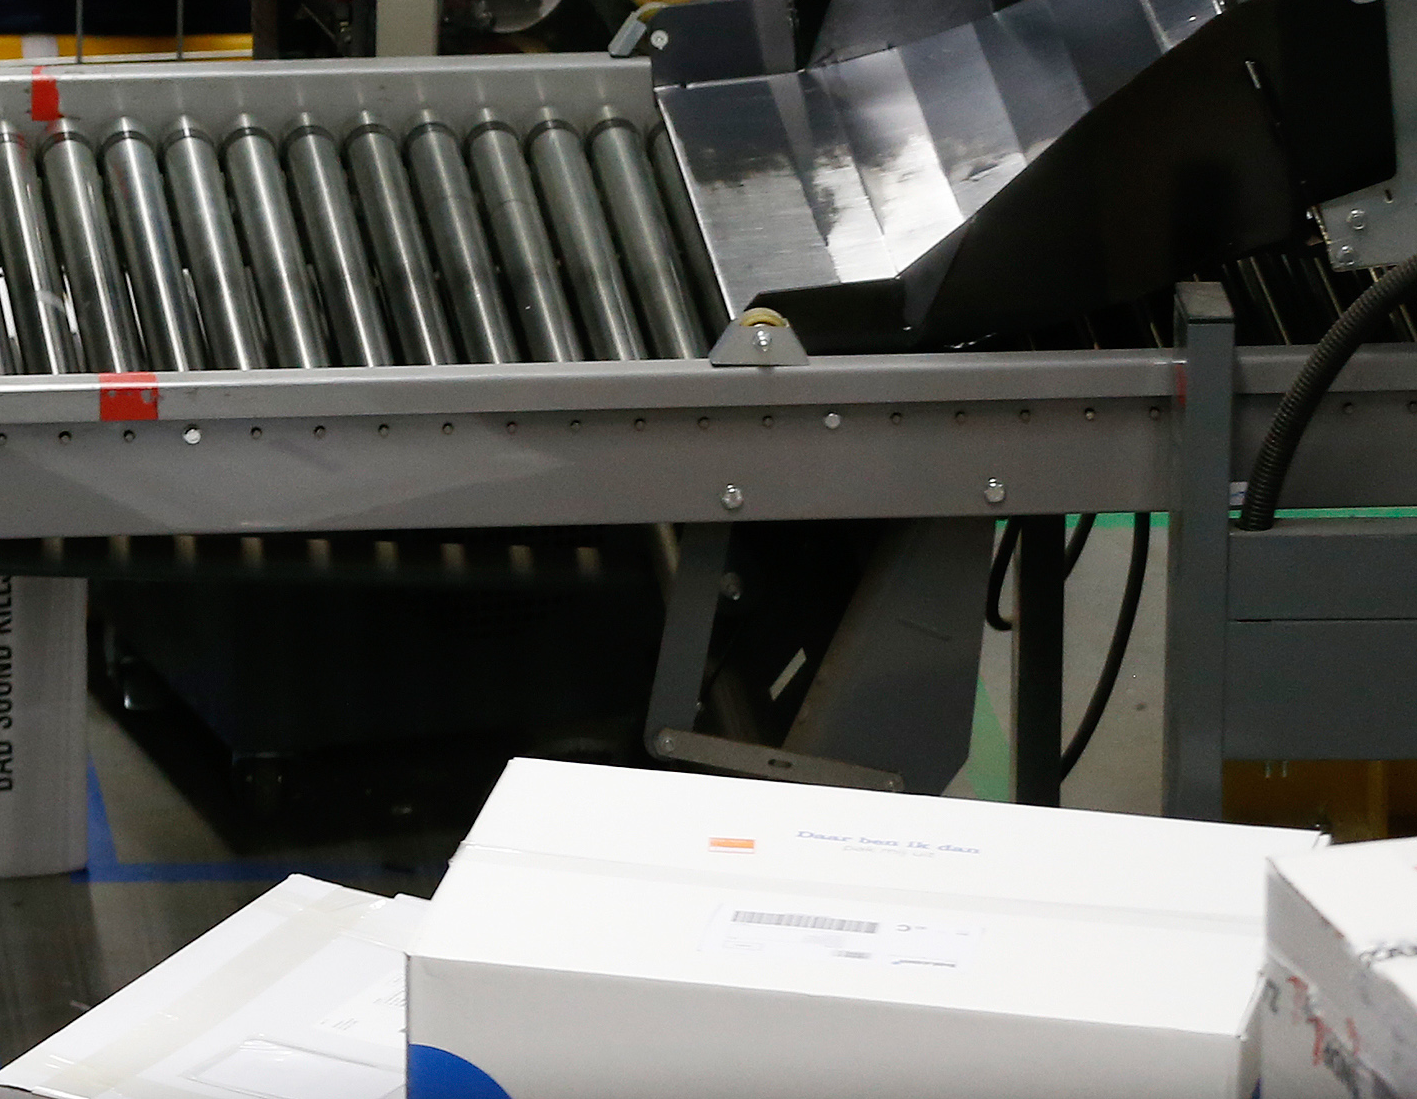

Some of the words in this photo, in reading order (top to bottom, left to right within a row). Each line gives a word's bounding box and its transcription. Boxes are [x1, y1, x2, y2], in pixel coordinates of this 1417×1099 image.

[796, 829, 853, 843] Daar
[858, 835, 899, 847] ben
[937, 842, 981, 854] dan
